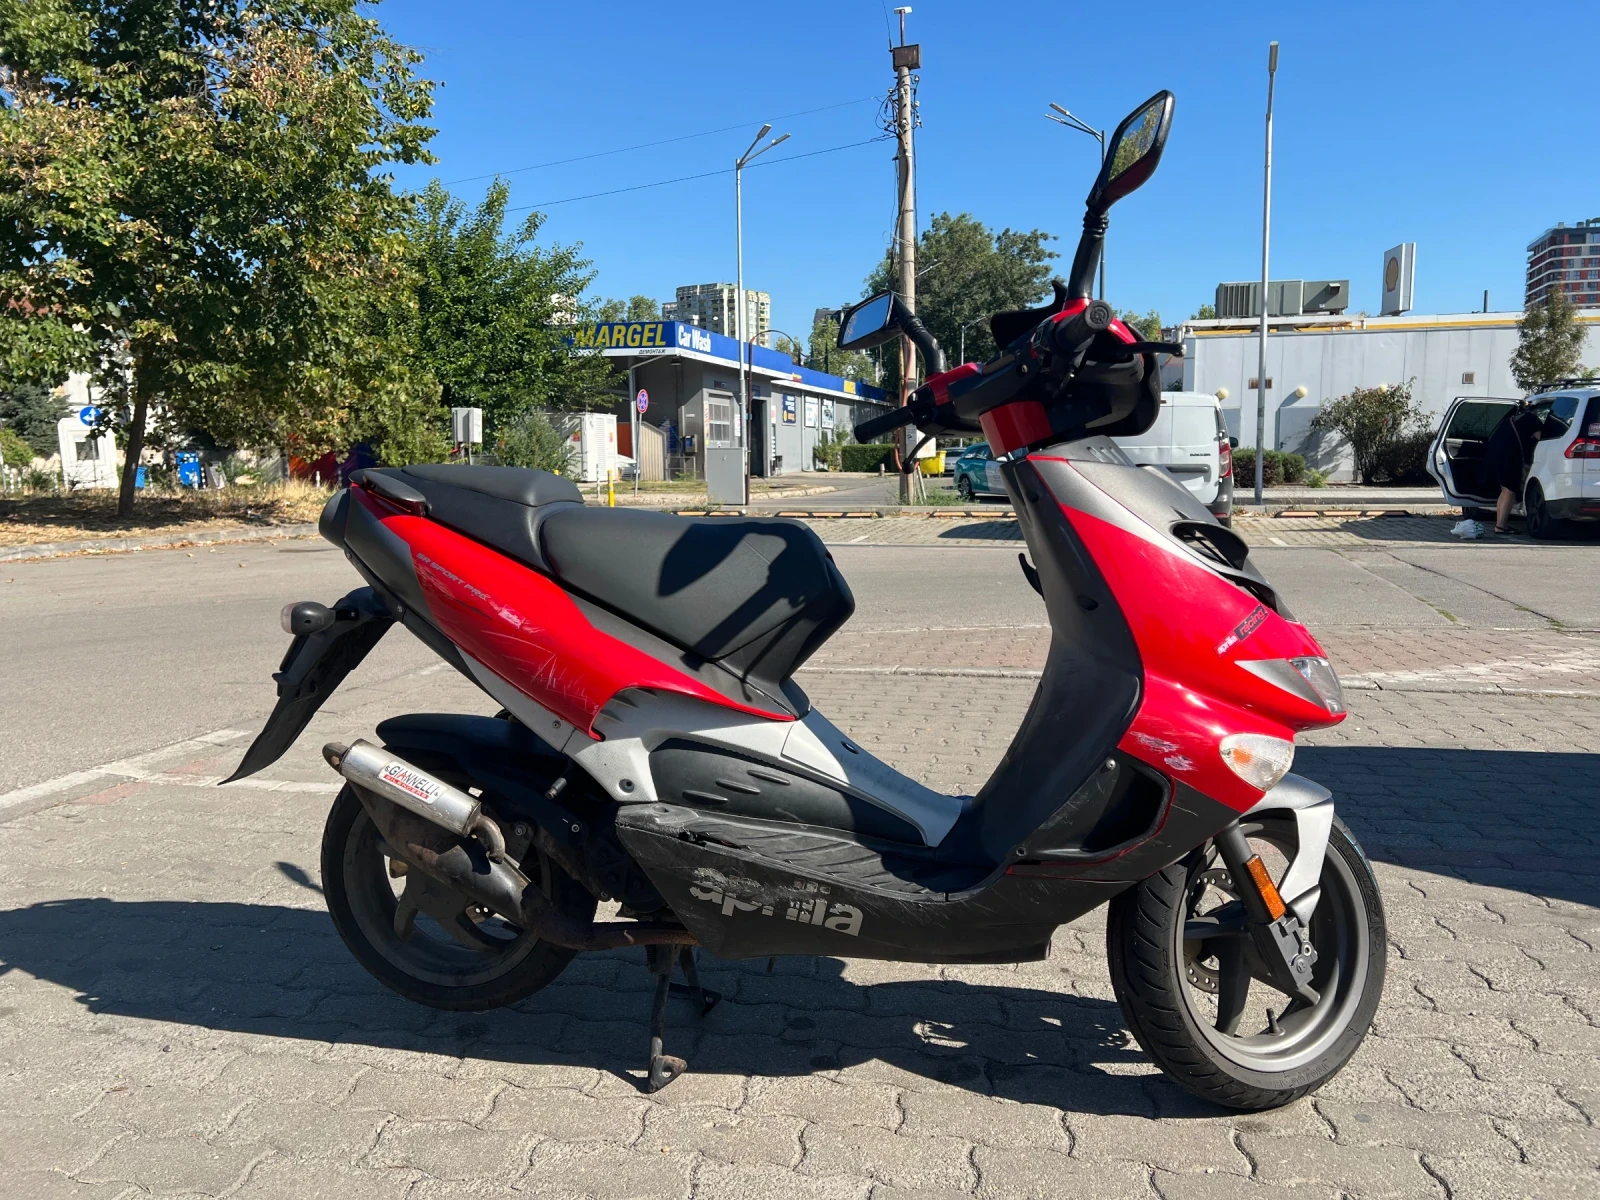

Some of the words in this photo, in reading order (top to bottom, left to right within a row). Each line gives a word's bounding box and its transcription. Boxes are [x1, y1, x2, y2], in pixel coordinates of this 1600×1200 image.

[573, 323, 667, 347] MARGEL
[678, 325, 691, 347] Car
[692, 330, 711, 352] Wash
[416, 553, 431, 564] SR
[430, 562, 465, 585] SPORT
[1217, 635, 1238, 655] aprilia
[1240, 608, 1265, 636] racing
[388, 765, 440, 796] GIANNELLI
[689, 868, 864, 937] apilia
